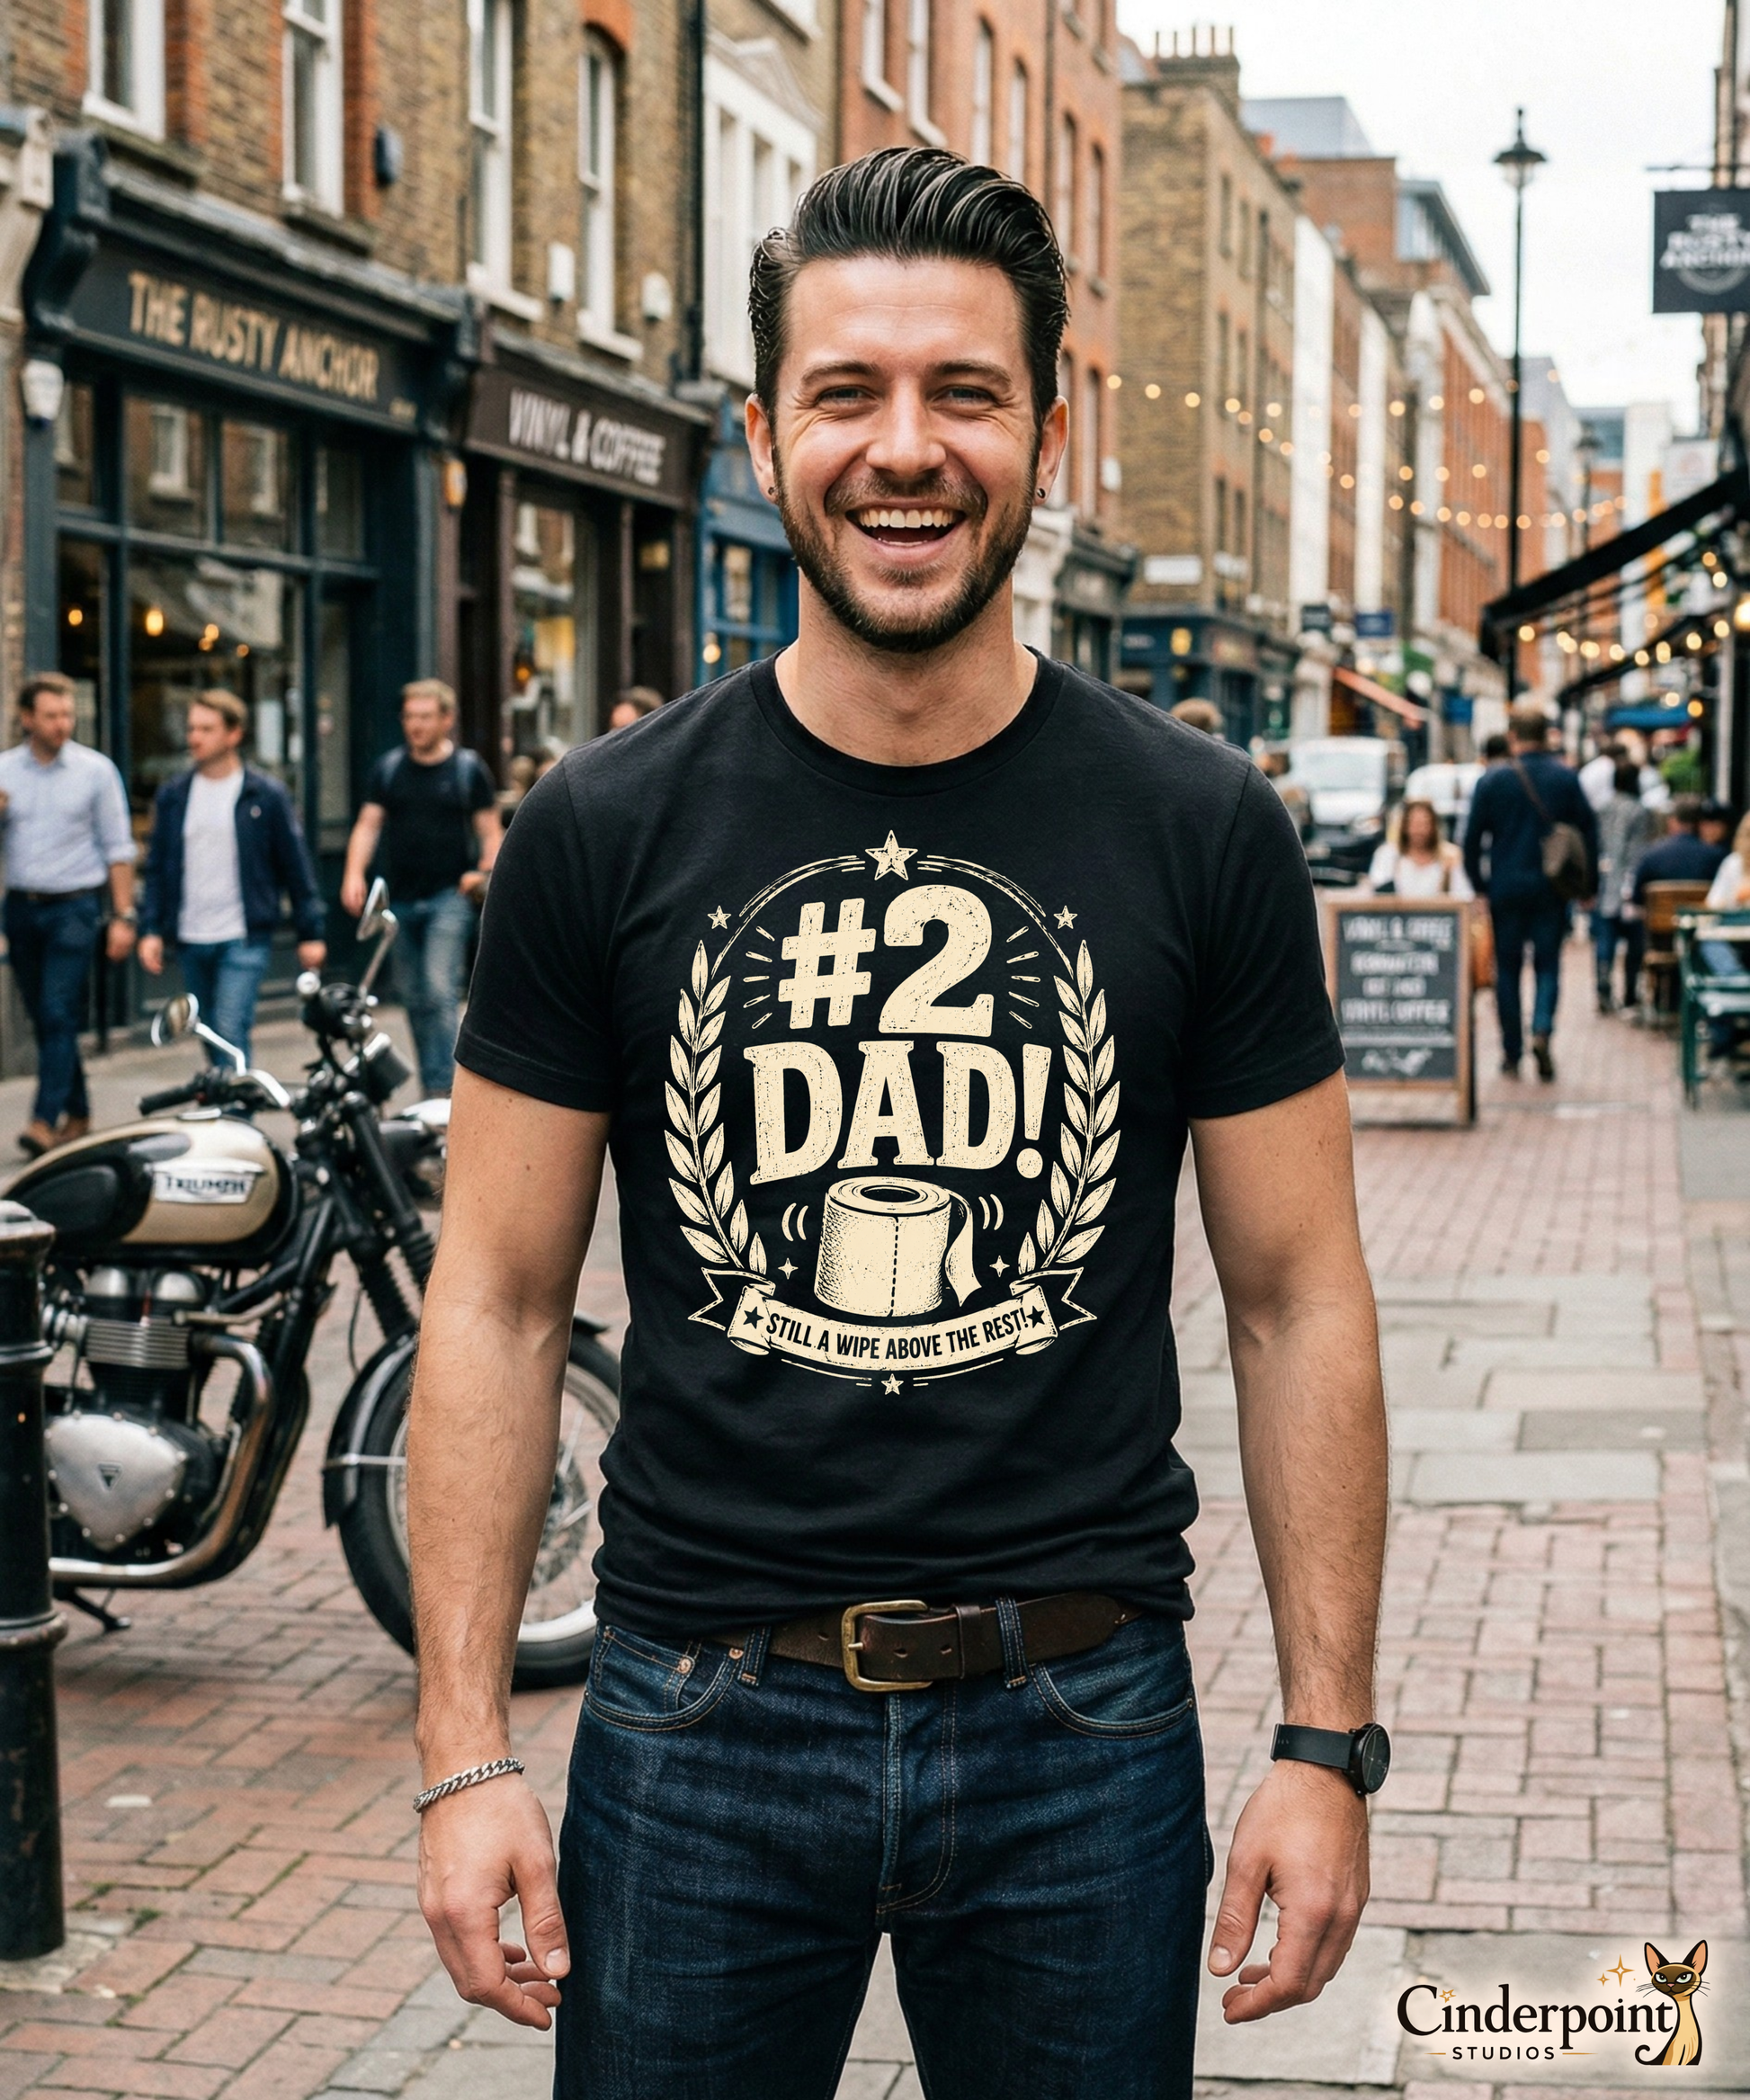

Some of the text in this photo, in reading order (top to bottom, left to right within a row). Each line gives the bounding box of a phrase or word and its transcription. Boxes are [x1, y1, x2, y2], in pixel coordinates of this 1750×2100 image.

[129, 272, 379, 402] THE RUSTY ANCHOR
[508, 387, 667, 486] VINYL & COFFEE
[778, 884, 994, 1037] #2
[743, 1041, 1052, 1185] DAD!
[165, 1175, 246, 1193] TRIUMPH
[766, 1307, 1029, 1360] STILL A WIPE ABOVE THE REST!
